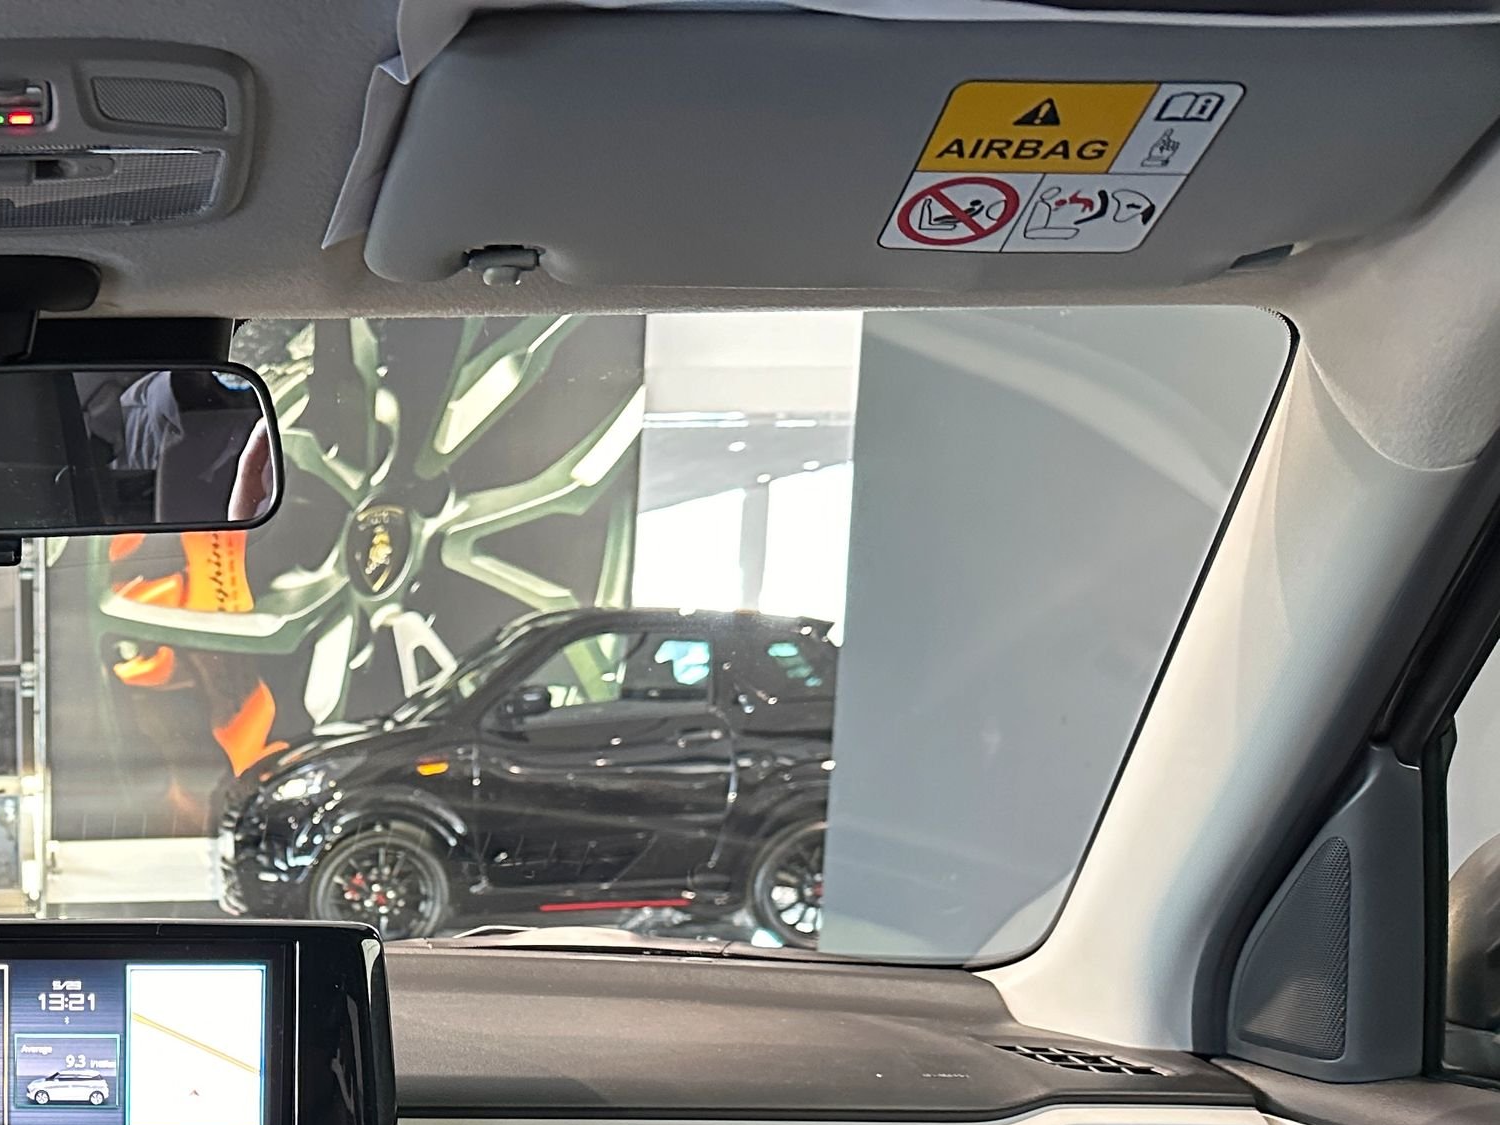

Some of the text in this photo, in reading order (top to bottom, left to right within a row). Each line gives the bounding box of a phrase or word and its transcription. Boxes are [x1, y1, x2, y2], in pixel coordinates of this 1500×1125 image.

[935, 138, 1110, 161] AIRBAG
[38, 993, 96, 1011] 13:21
[21, 1044, 52, 1055] Average
